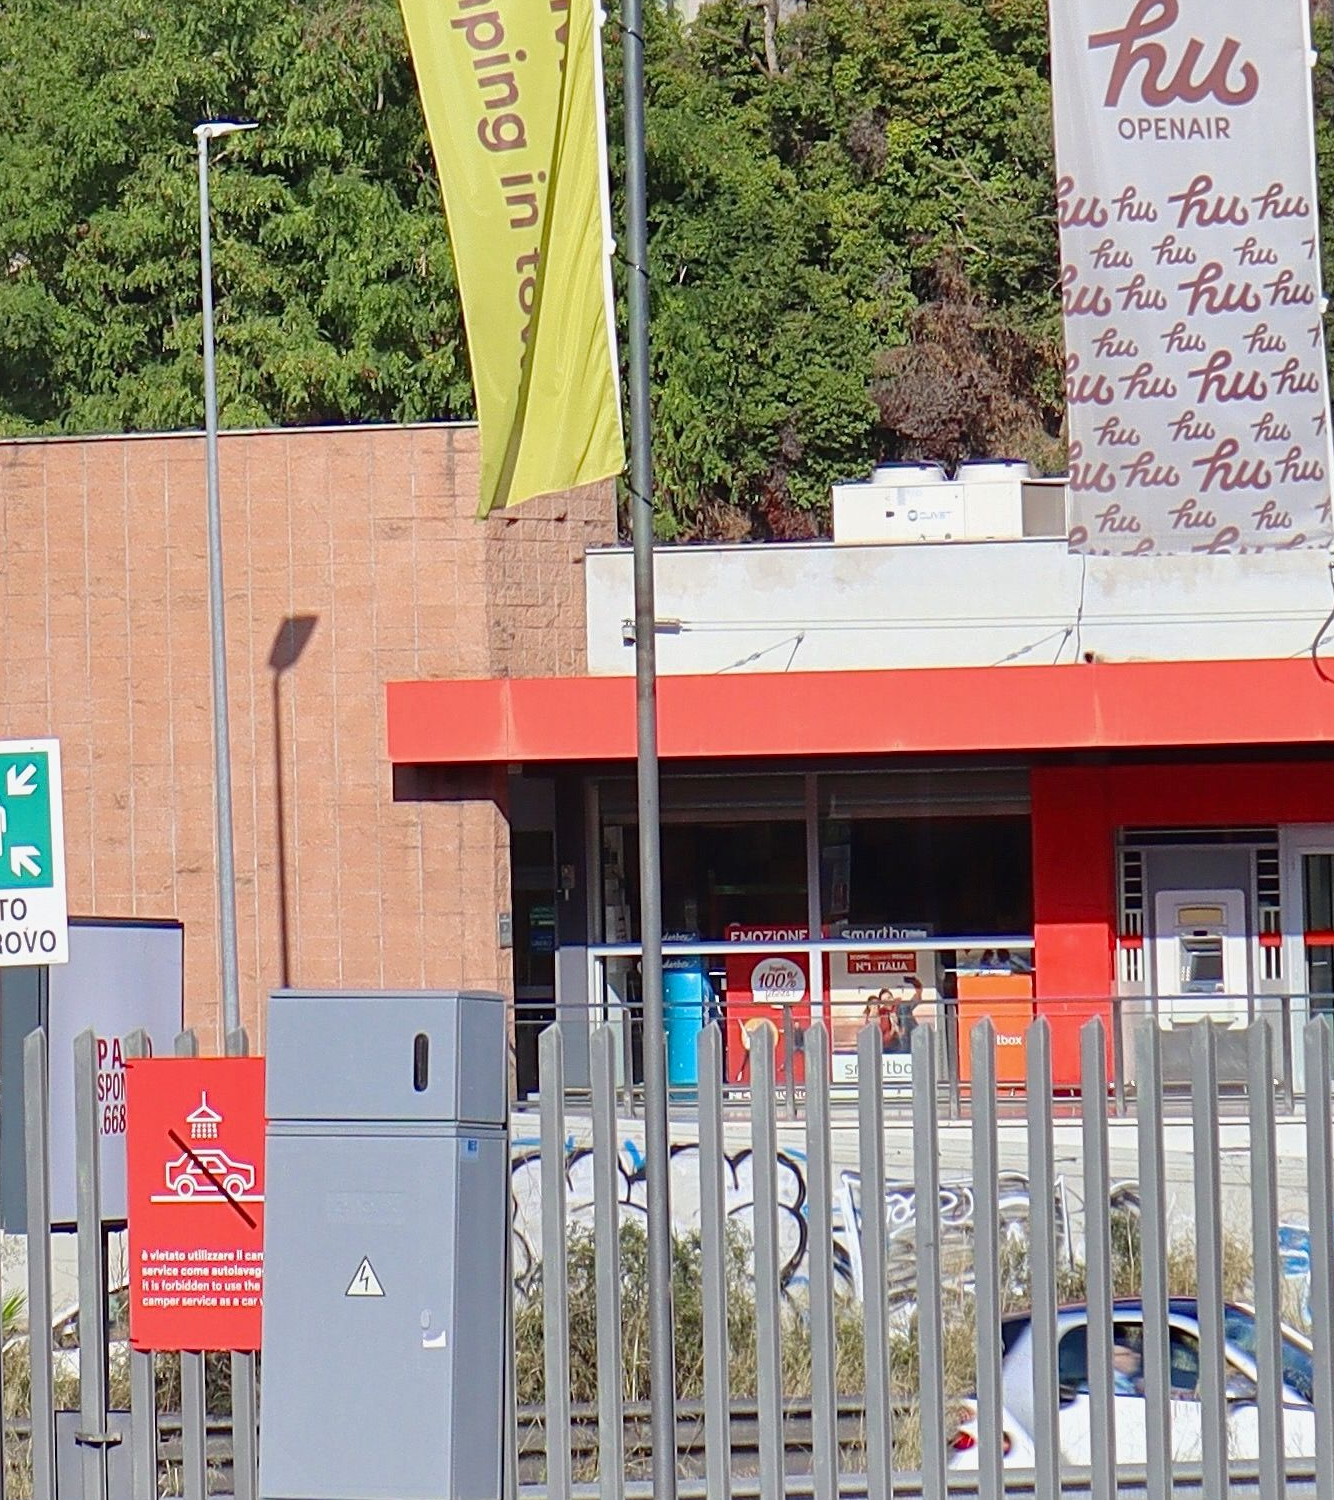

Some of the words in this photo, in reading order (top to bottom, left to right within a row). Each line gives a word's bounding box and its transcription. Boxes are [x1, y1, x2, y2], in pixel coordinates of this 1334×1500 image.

[1118, 117, 1230, 140] OPENAIR
[500, 171, 547, 230] in
[758, 971, 798, 989] 100%
[150, 1250, 185, 1261] vietato
[187, 1250, 234, 1261] utilizzare
[142, 1265, 178, 1277] service
[180, 1267, 209, 1277] come
[211, 1265, 264, 1279] autolavag
[161, 1280, 209, 1292] forbidden
[212, 1280, 222, 1292] to
[224, 1282, 241, 1292] use
[244, 1280, 260, 1292] the
[142, 1297, 179, 1308] camper
[181, 1295, 217, 1307] service
[219, 1297, 230, 1307] as
[241, 1297, 257, 1307] car
